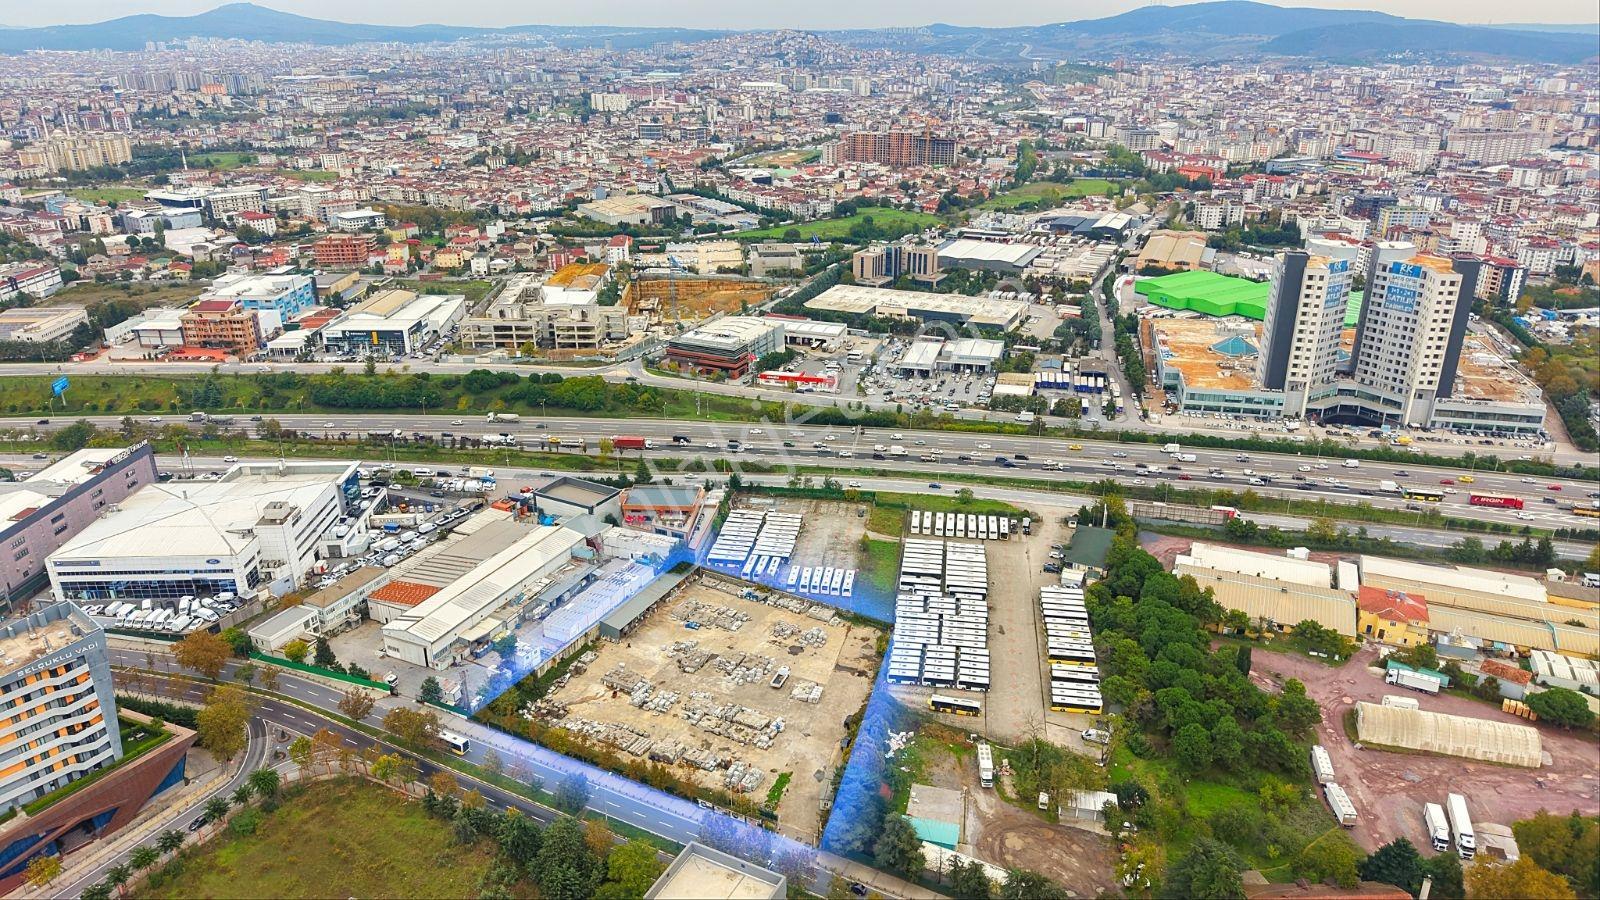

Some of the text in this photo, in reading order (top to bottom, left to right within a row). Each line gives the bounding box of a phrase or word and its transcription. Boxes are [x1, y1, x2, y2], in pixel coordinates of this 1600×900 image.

[1400, 263, 1413, 274] RK
[1386, 294, 1415, 305] SATILIK
[16, 653, 73, 677] SELÇUKLU
